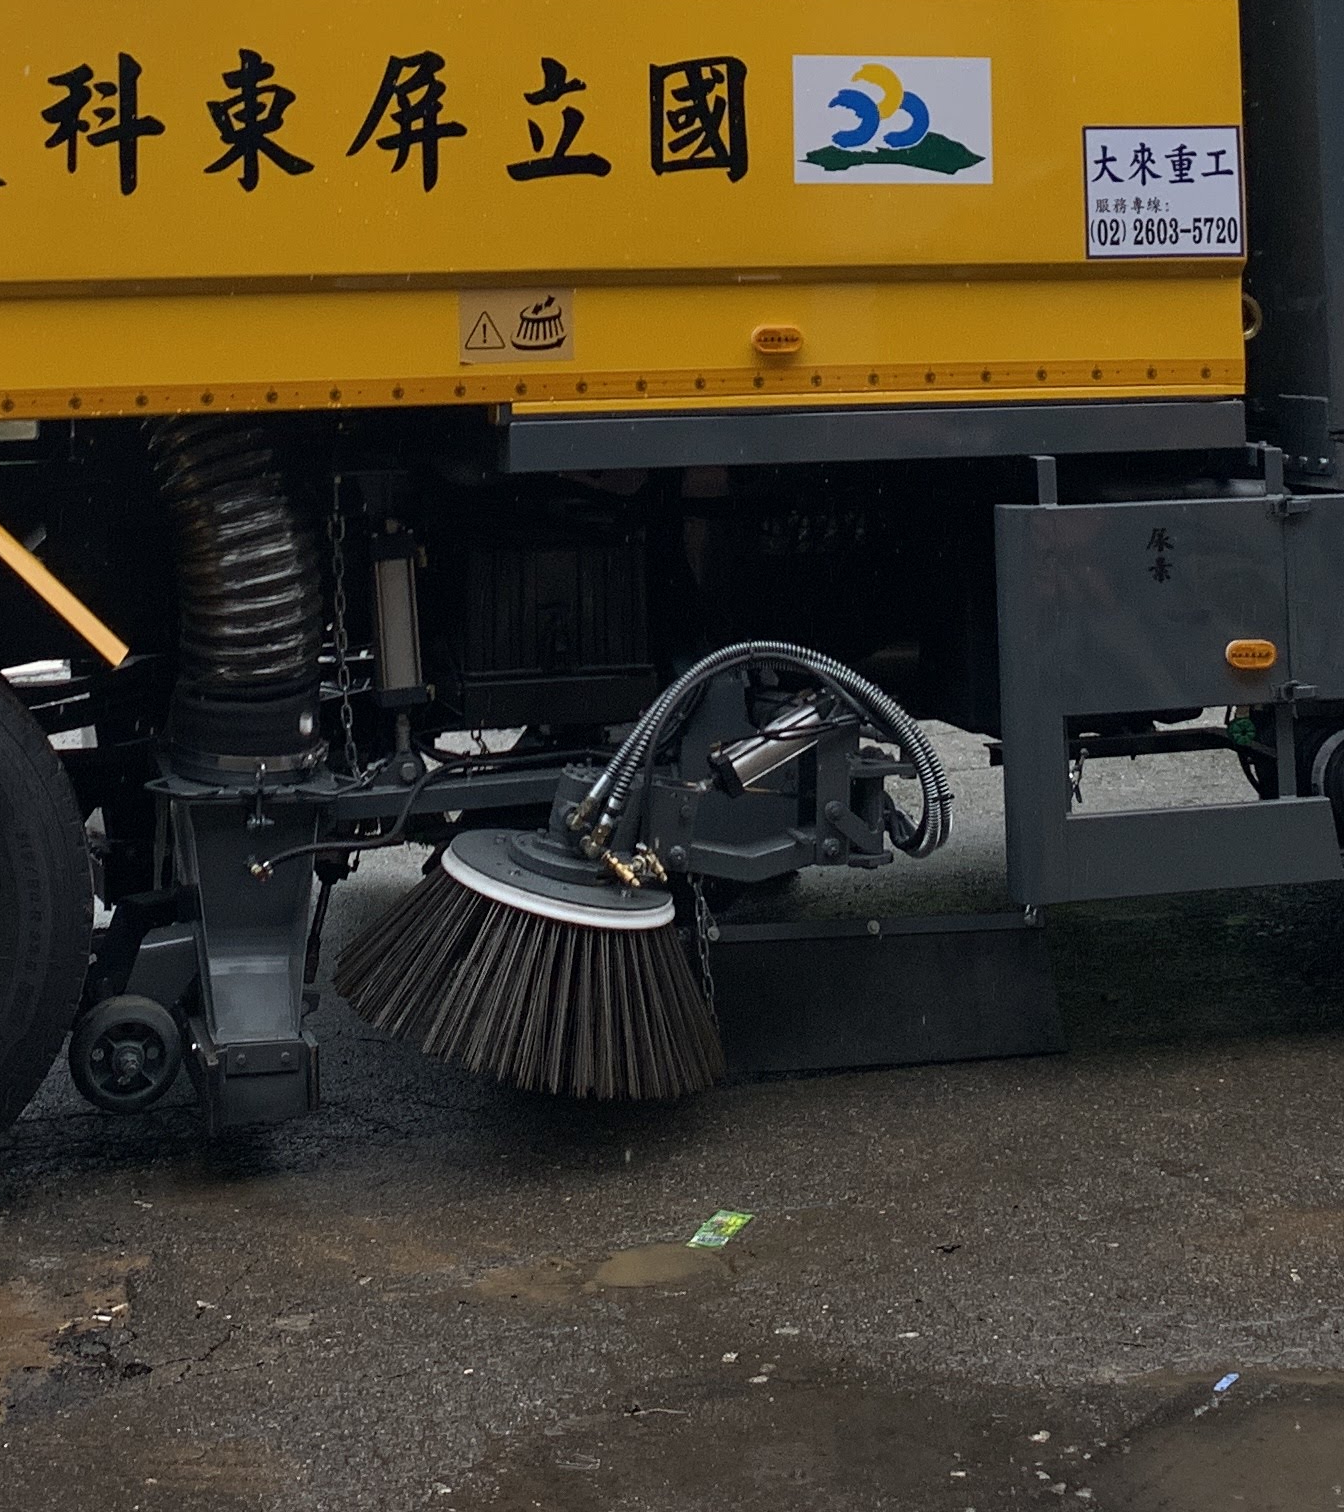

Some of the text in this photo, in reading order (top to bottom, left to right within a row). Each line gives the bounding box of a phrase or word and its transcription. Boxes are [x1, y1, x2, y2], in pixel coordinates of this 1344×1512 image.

[1091, 142, 1235, 187] 大來重工
[1090, 216, 1238, 246] (02) 2603-5720
